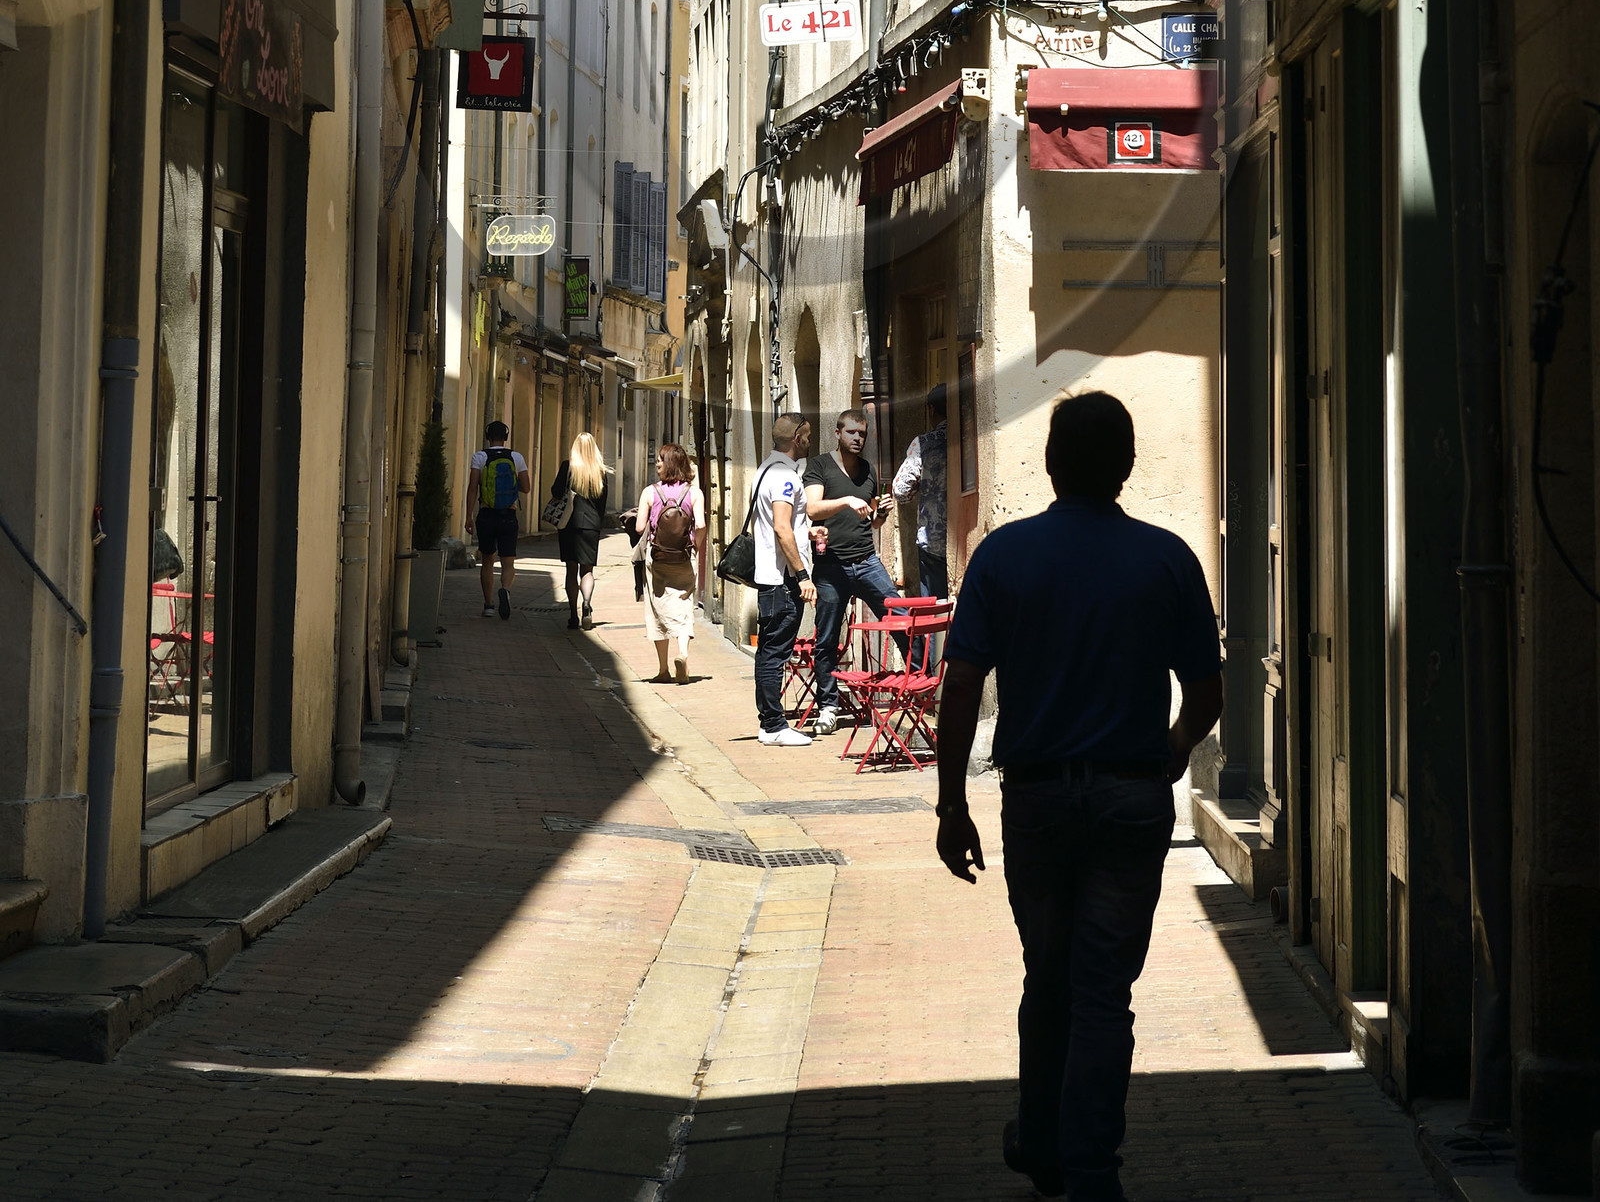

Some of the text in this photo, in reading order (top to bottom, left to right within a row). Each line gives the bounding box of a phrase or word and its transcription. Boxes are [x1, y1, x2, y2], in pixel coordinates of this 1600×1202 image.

[767, 9, 853, 34] Le 421
[1046, 5, 1083, 22] RUE
[1054, 24, 1075, 34] DES
[1171, 22, 1197, 33] CALLE
[1034, 34, 1094, 52] PATINS
[256, 30, 290, 108] Love
[1124, 134, 1143, 143] 421
[487, 224, 553, 252] Regarde
[565, 273, 588, 293] Marco
[569, 289, 588, 308] Polo
[782, 481, 794, 498] 2
